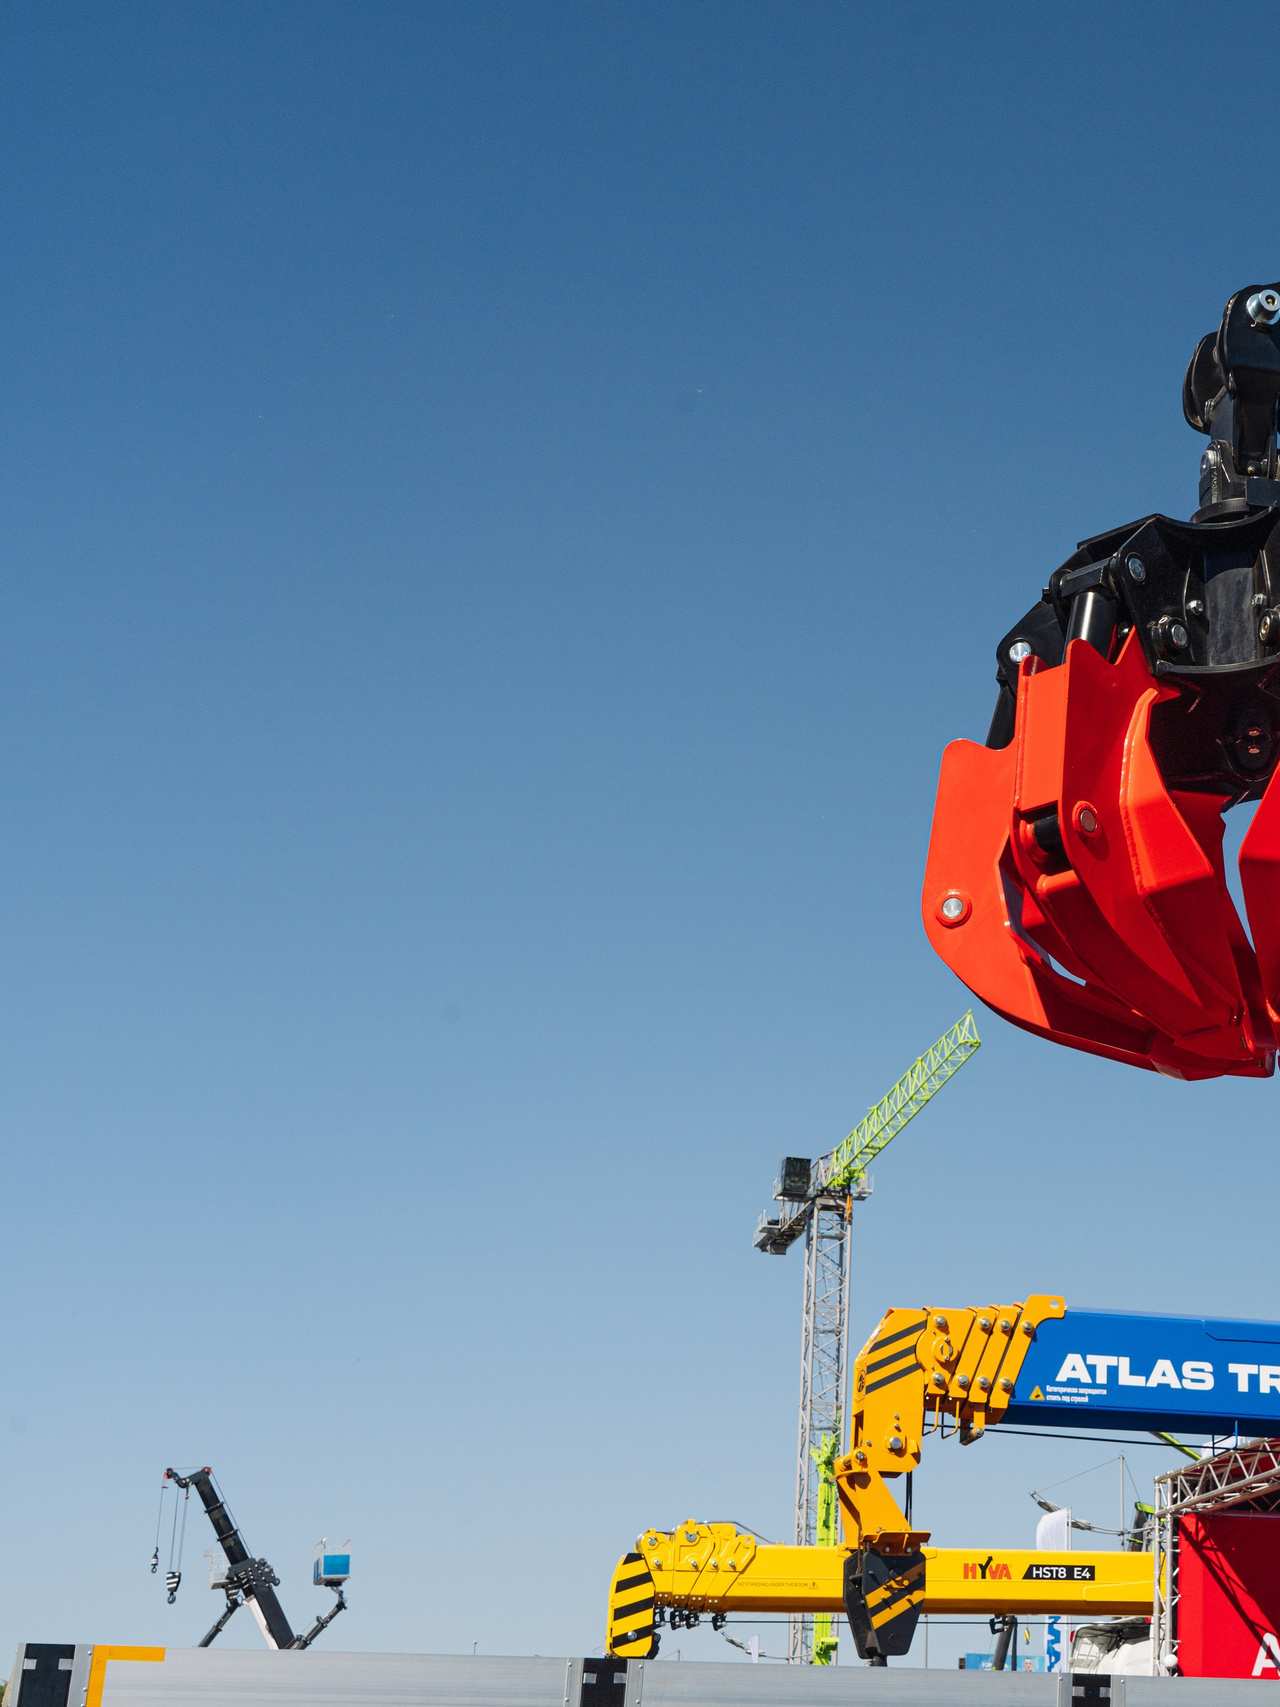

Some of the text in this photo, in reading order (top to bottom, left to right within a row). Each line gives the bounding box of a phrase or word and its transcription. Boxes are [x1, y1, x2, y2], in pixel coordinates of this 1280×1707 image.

[1055, 1353, 1214, 1391] ATLAS
[963, 1556, 1012, 1580] HYVA
[1032, 1566, 1091, 1579] HST8 E4
